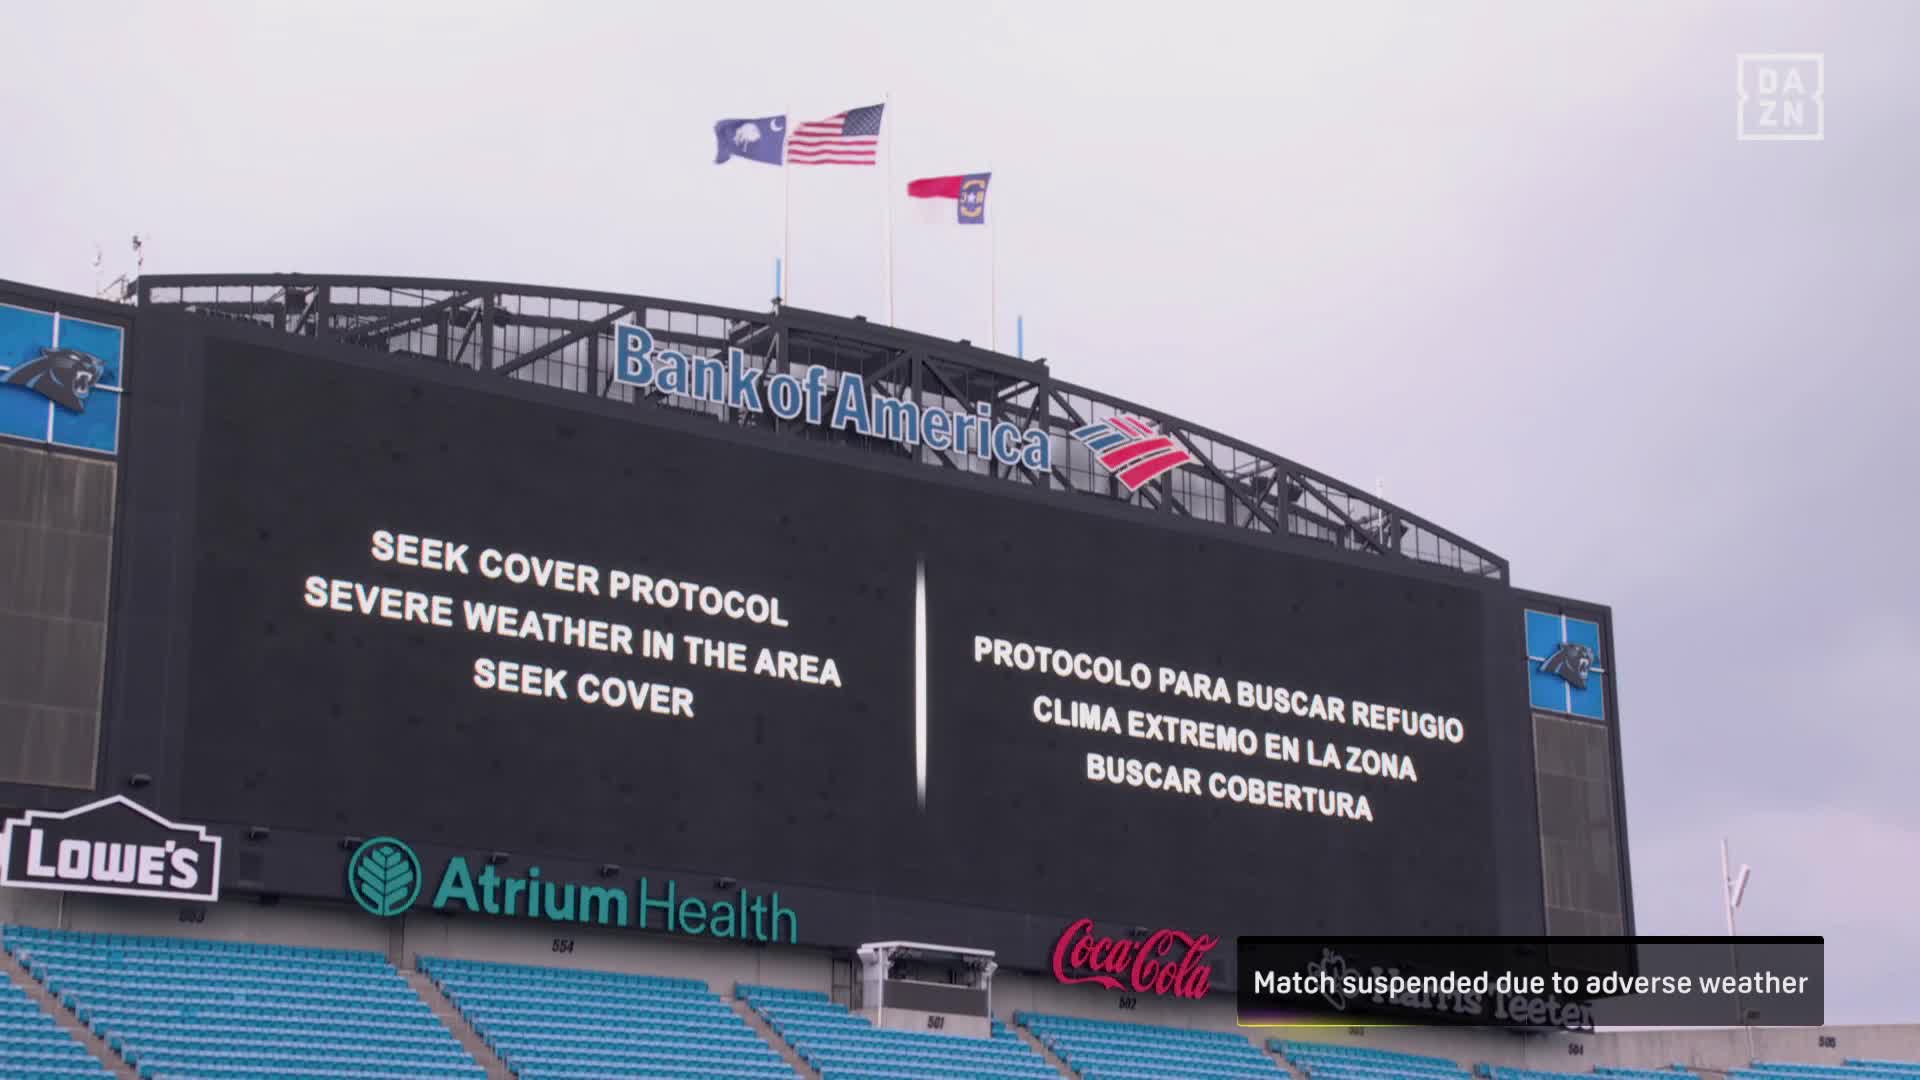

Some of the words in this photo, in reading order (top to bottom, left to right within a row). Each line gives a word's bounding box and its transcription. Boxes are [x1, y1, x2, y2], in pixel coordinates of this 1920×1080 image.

[614, 320, 763, 412] Bank
[767, 364, 827, 424] of
[831, 371, 1050, 472] America
[371, 529, 470, 575] SEEK
[479, 548, 600, 596] COVER
[609, 569, 789, 628] PROTOCOL
[303, 575, 454, 627] SEVERE
[463, 599, 633, 655] WEATHER
[642, 628, 675, 661] IN
[683, 634, 748, 673] THE
[754, 647, 842, 688] AREA
[473, 657, 568, 700] SEEK
[576, 673, 695, 718] COVER
[974, 635, 1152, 690] PROTOCOLO
[1158, 666, 1232, 705] PARA
[1236, 680, 1347, 724] BUSCAR
[1351, 700, 1465, 744] REFUGIO
[1033, 695, 1122, 735] CLIMA
[1127, 709, 1258, 756] EXTREMO
[1264, 732, 1300, 763] EN
[1306, 739, 1342, 770] LA
[1345, 745, 1418, 783] ZONA
[1086, 752, 1203, 796] BUSCAR
[1208, 771, 1374, 822] COBERTURA
[26, 828, 199, 889] LOWE'S
[432, 856, 629, 927] Atrium
[638, 876, 798, 944] Health
